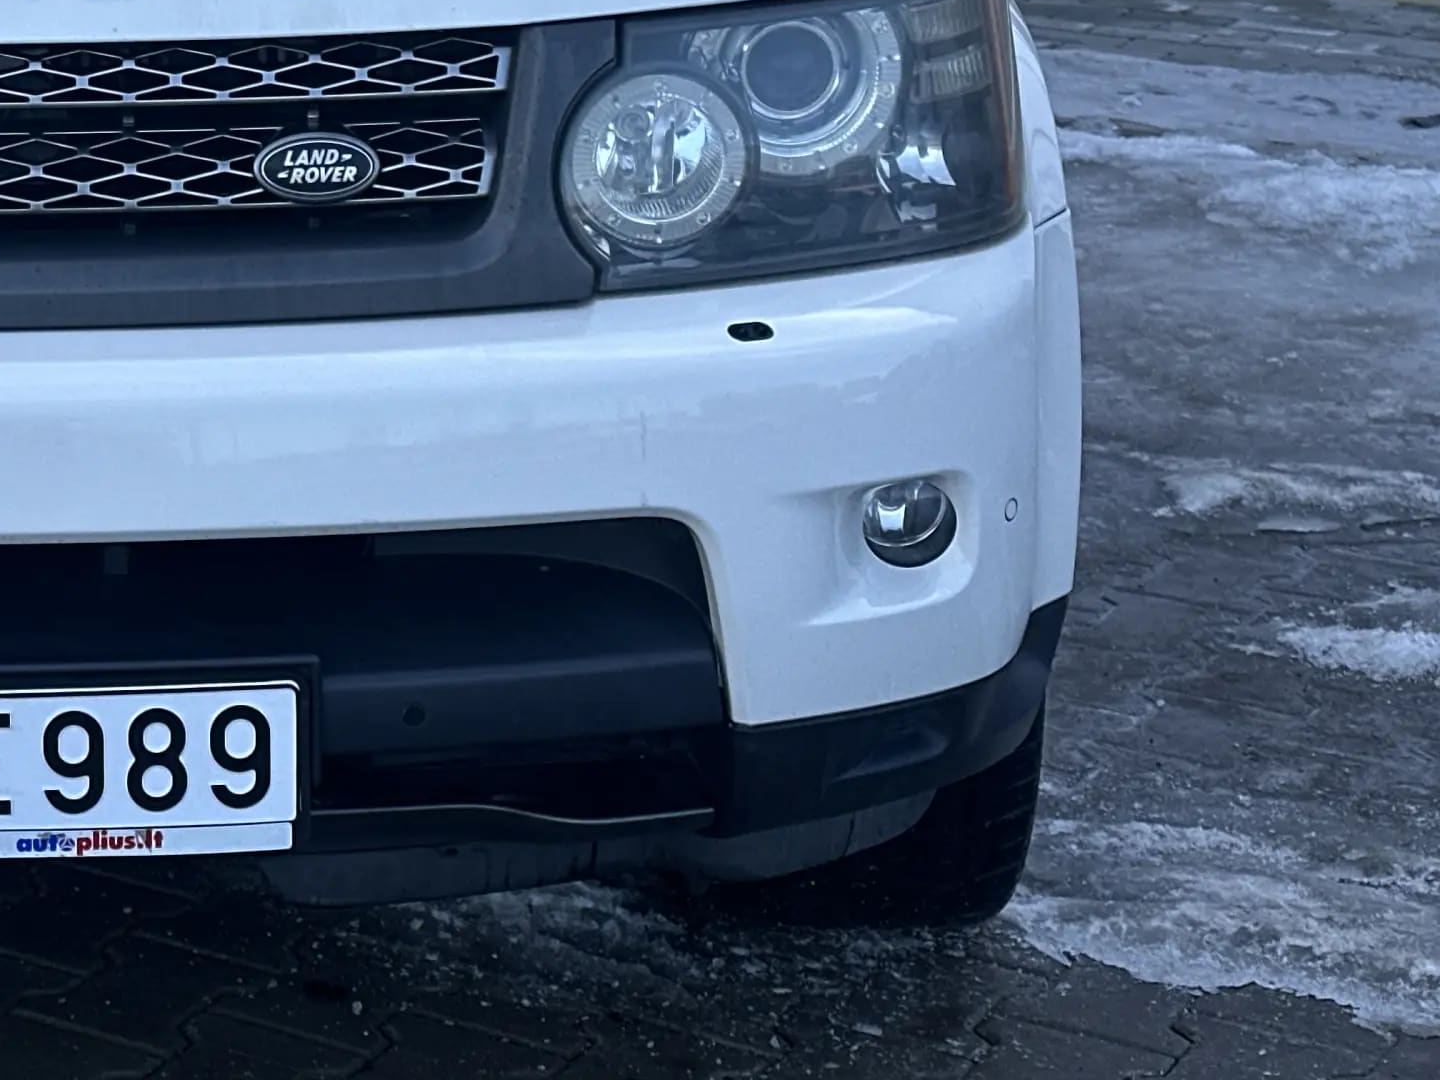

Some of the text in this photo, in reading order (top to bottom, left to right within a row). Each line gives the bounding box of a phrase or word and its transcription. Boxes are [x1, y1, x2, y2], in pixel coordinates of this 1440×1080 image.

[283, 149, 340, 167] LAND
[288, 166, 358, 184] ROVER
[42, 704, 272, 814] 989
